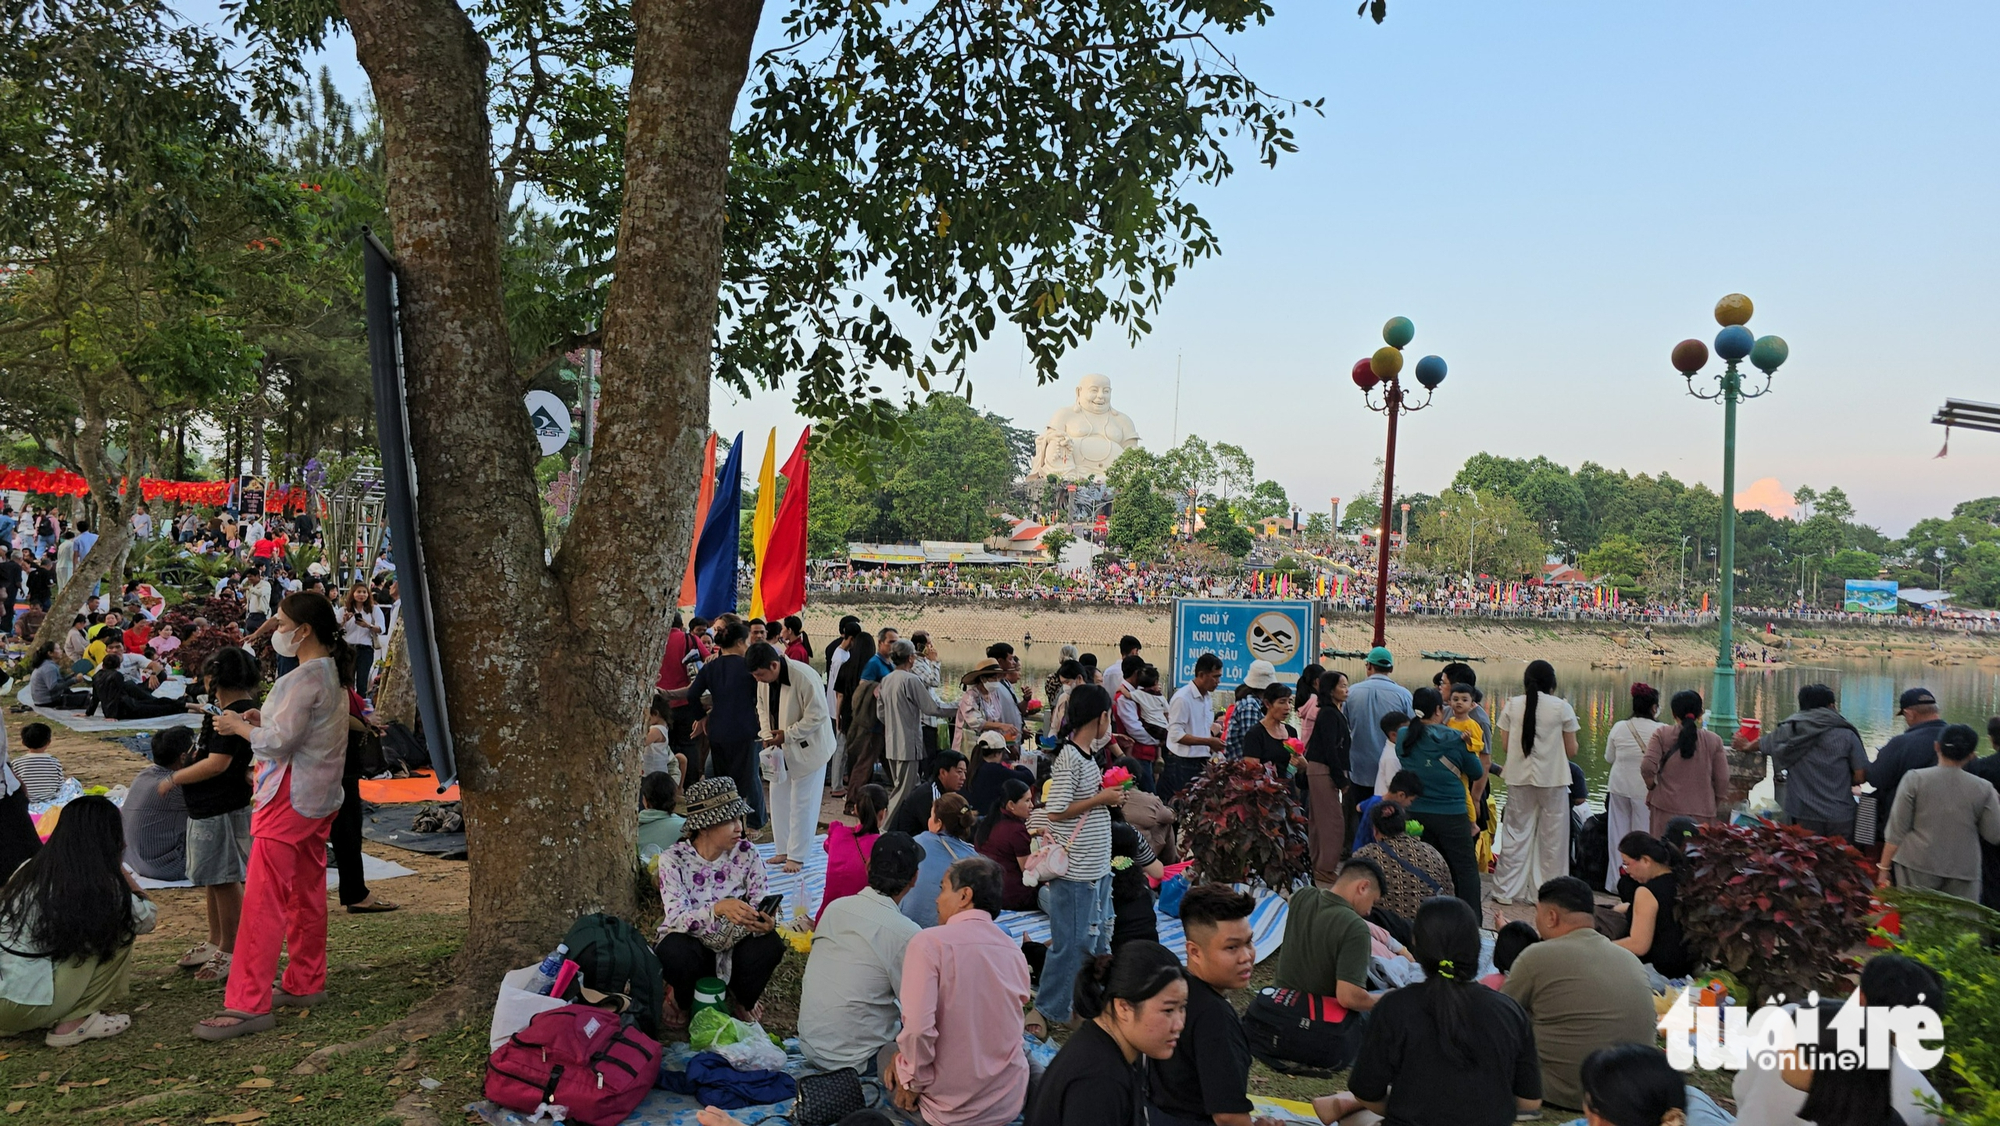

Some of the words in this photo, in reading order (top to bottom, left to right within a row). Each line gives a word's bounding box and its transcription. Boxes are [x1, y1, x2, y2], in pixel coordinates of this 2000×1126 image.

[1199, 611, 1220, 624] CHÚ
[1222, 611, 1229, 625] Ý
[1192, 631, 1213, 642] KHU
[1215, 630, 1235, 645] VỰC
[1218, 647, 1238, 661] SÂU
[1226, 666, 1242, 681] LỘI
